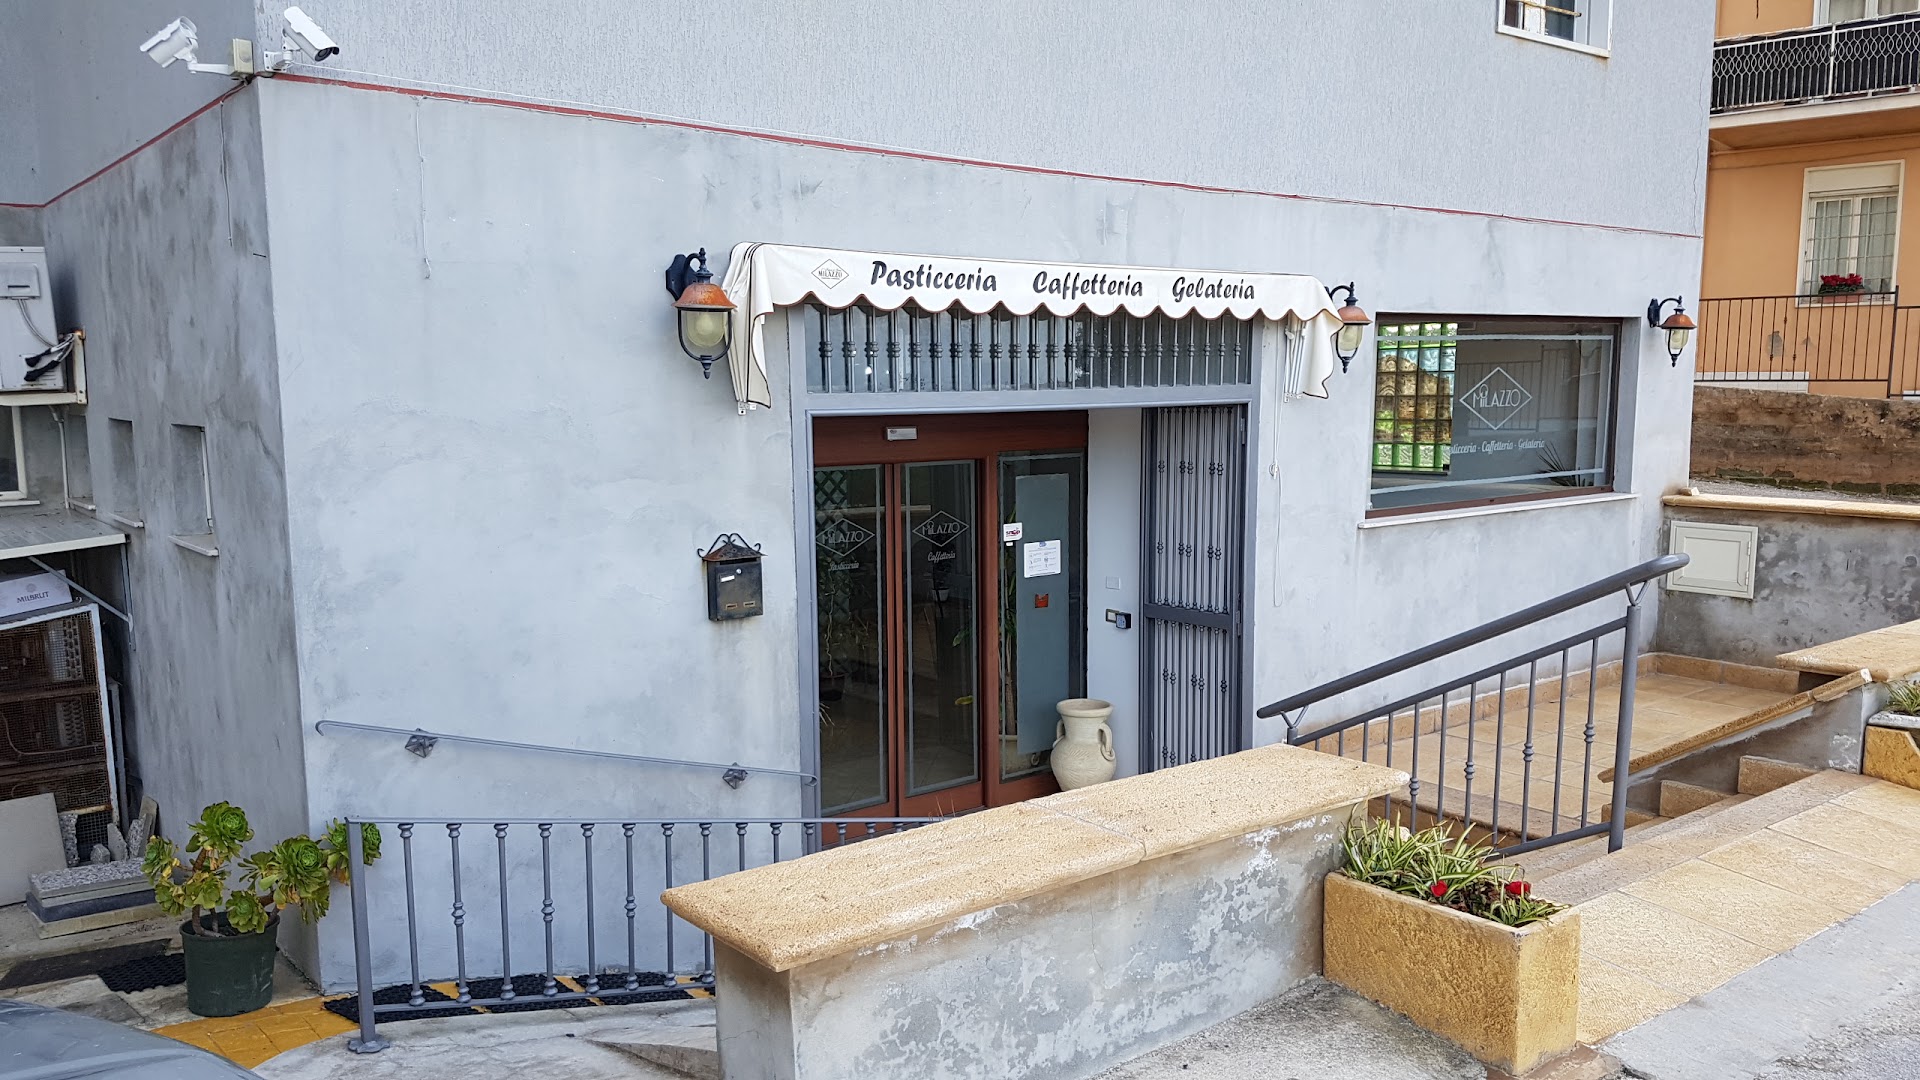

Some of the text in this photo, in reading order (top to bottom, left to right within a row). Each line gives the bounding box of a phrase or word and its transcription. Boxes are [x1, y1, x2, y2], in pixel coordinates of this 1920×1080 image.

[870, 260, 1255, 303] Pasticceria Caffetteria Gelateria
[1472, 384, 1521, 408] MILAZZO
[1481, 440, 1513, 455] Caffetteria
[1518, 438, 1545, 450] Gelateria
[822, 529, 864, 544] MILAZZO
[922, 521, 960, 535] MILAZZO
